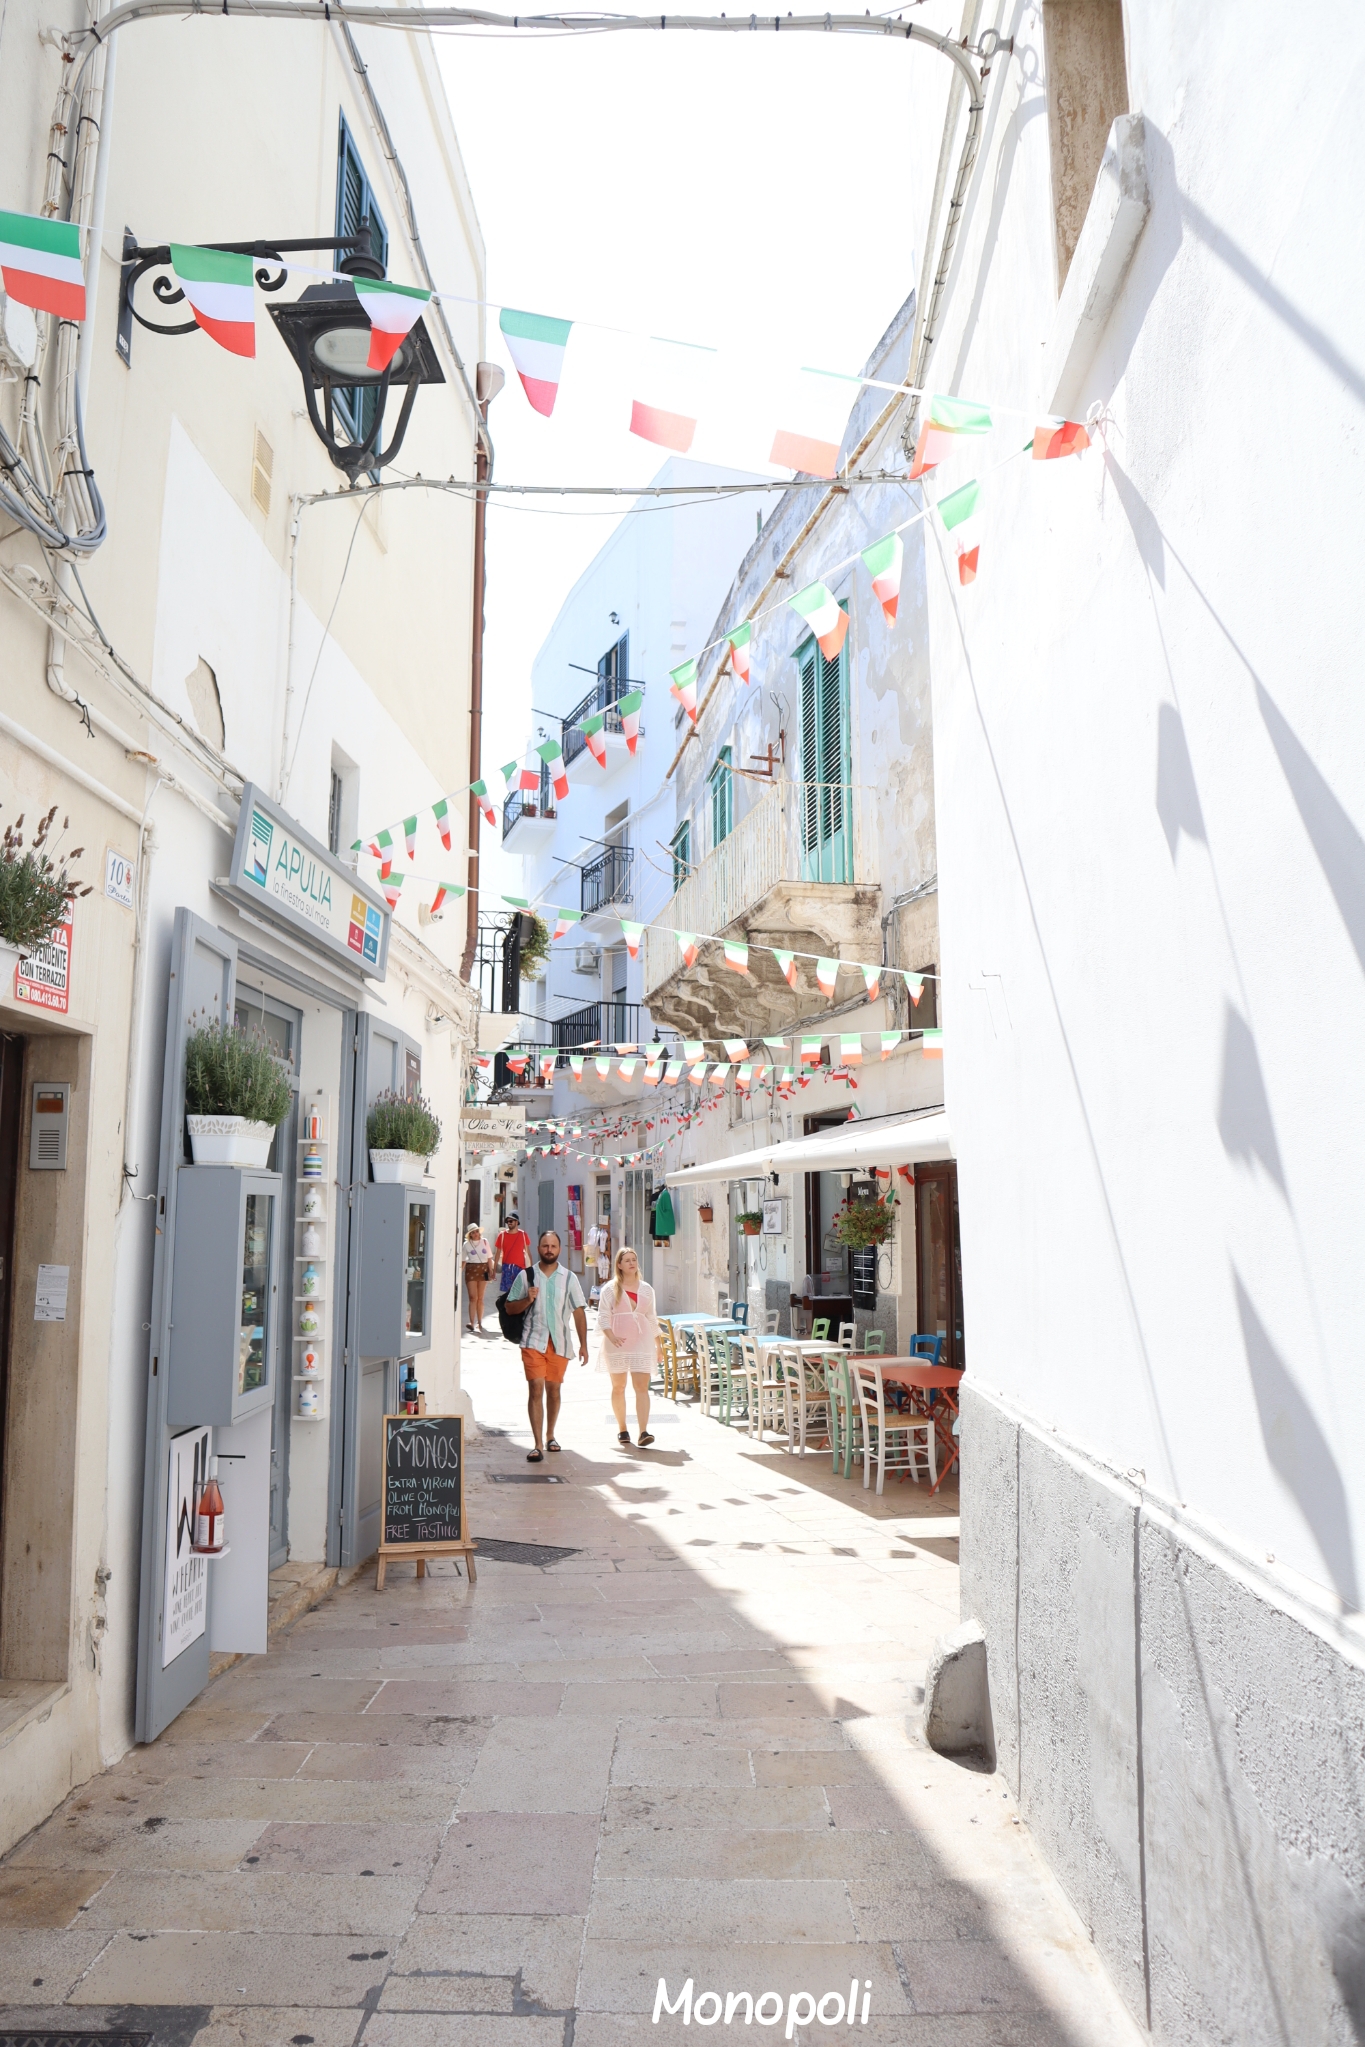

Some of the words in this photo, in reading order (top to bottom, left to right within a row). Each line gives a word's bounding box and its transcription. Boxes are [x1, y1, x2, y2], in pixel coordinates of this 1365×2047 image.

[111, 858, 124, 885] 10
[275, 840, 332, 911] APULIA
[273, 877, 280, 893] la
[280, 882, 305, 913] finestra
[305, 903, 315, 920] sul
[315, 911, 330, 929] mare
[20, 960, 34, 978] CON
[35, 964, 66, 989] TERRAZZO
[396, 1433, 459, 1469] MONOS
[387, 1504, 413, 1517] FROM
[417, 1491, 438, 1503] OIL
[385, 1523, 410, 1539] FREE
[415, 1521, 458, 1540] TASTING
